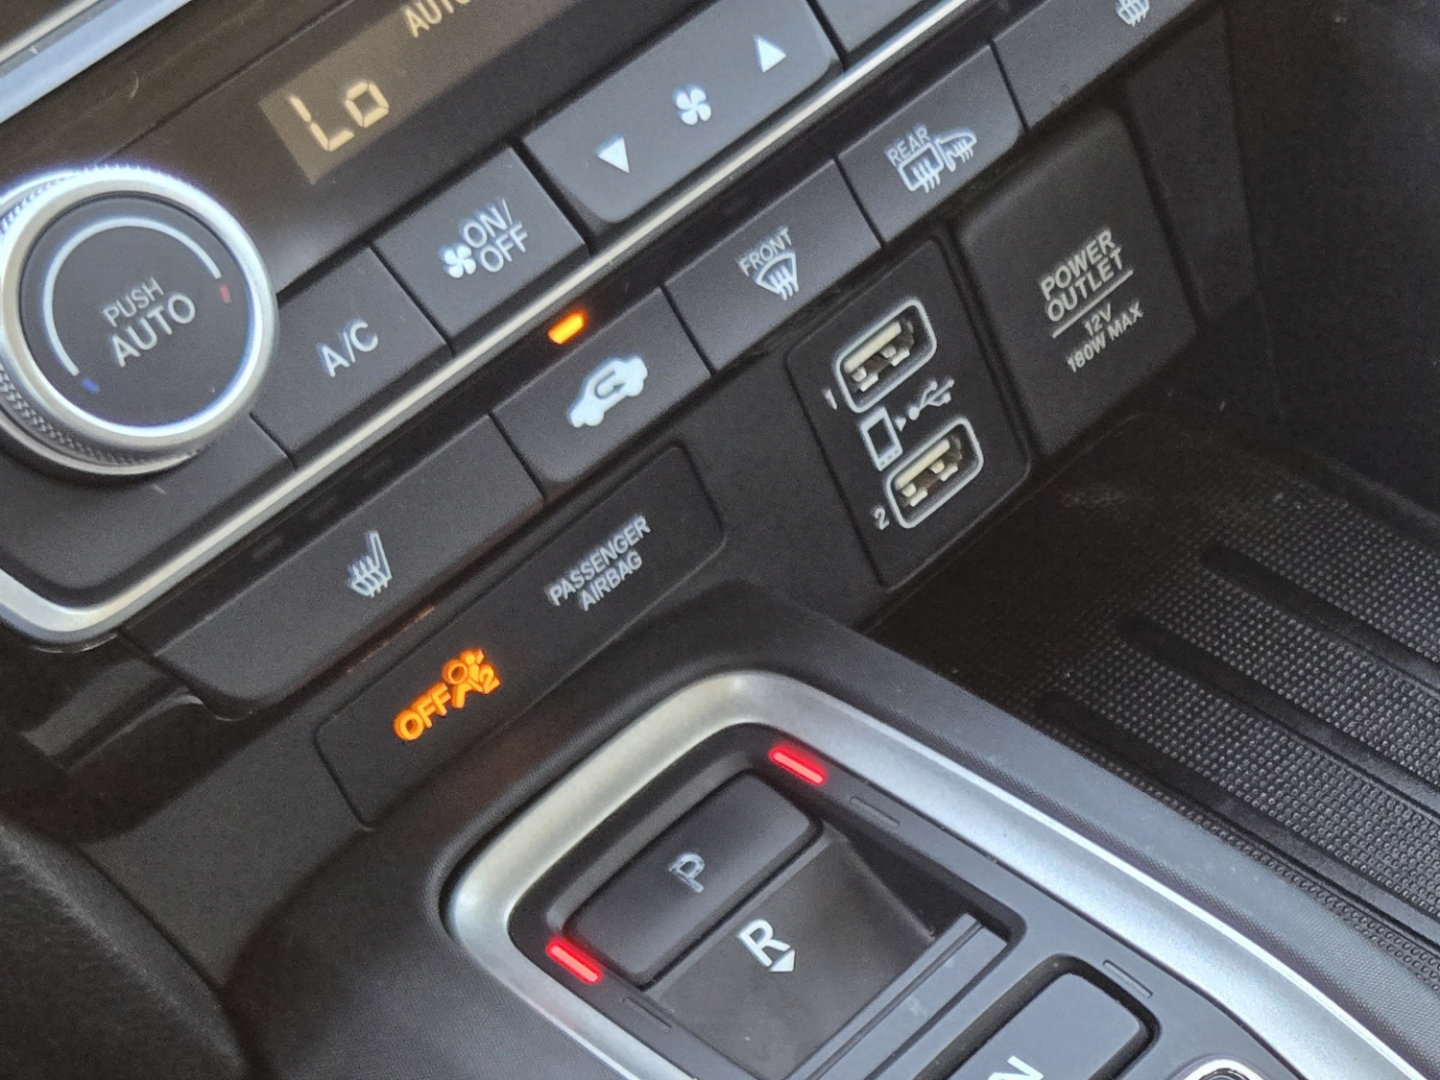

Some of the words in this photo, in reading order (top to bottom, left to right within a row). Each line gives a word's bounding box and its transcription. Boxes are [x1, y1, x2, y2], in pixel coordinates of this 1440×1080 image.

[289, 79, 389, 153] Lo
[885, 124, 931, 168] REAR
[461, 198, 513, 249] ON/
[479, 220, 529, 273] OFF
[736, 225, 794, 277] FRONT
[1038, 227, 1117, 302] POWER
[1046, 245, 1123, 322] OUTLET
[102, 276, 165, 328] PUSH
[111, 292, 196, 368] AUTO
[1084, 301, 1112, 336] 12V
[316, 319, 379, 378] A/C
[1066, 330, 1106, 373] 180W
[1107, 300, 1144, 341] MAX
[872, 505, 890, 531] 2
[545, 513, 652, 607] PASSENGER
[579, 549, 643, 612] AIRBAG
[393, 681, 452, 741] OFF
[669, 853, 705, 893] P
[737, 918, 790, 968] R
